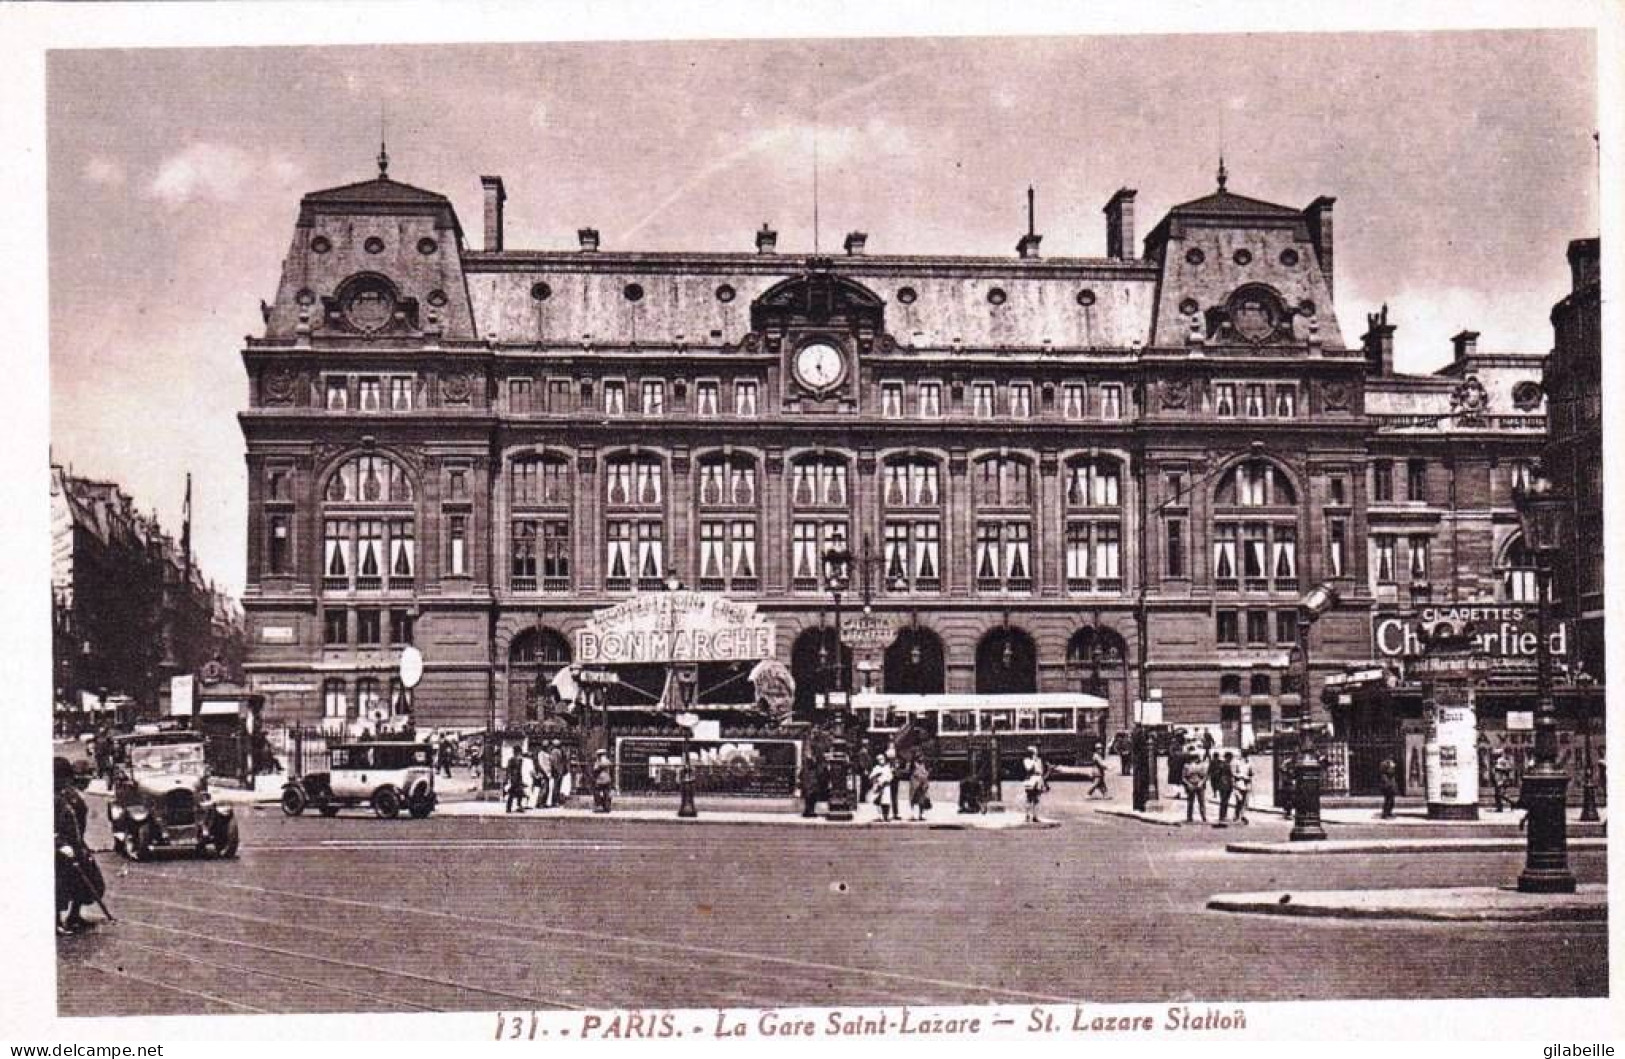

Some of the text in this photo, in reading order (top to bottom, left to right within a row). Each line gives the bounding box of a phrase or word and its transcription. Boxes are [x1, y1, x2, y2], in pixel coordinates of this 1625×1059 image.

[1376, 619, 1567, 656] Cherfied
[715, 1010, 747, 1037] La
[758, 1011, 815, 1036] Gare
[825, 1007, 981, 1036] Saint-Lazare
[1072, 1008, 1153, 1031] Lazare
[1165, 1007, 1247, 1030] Station
